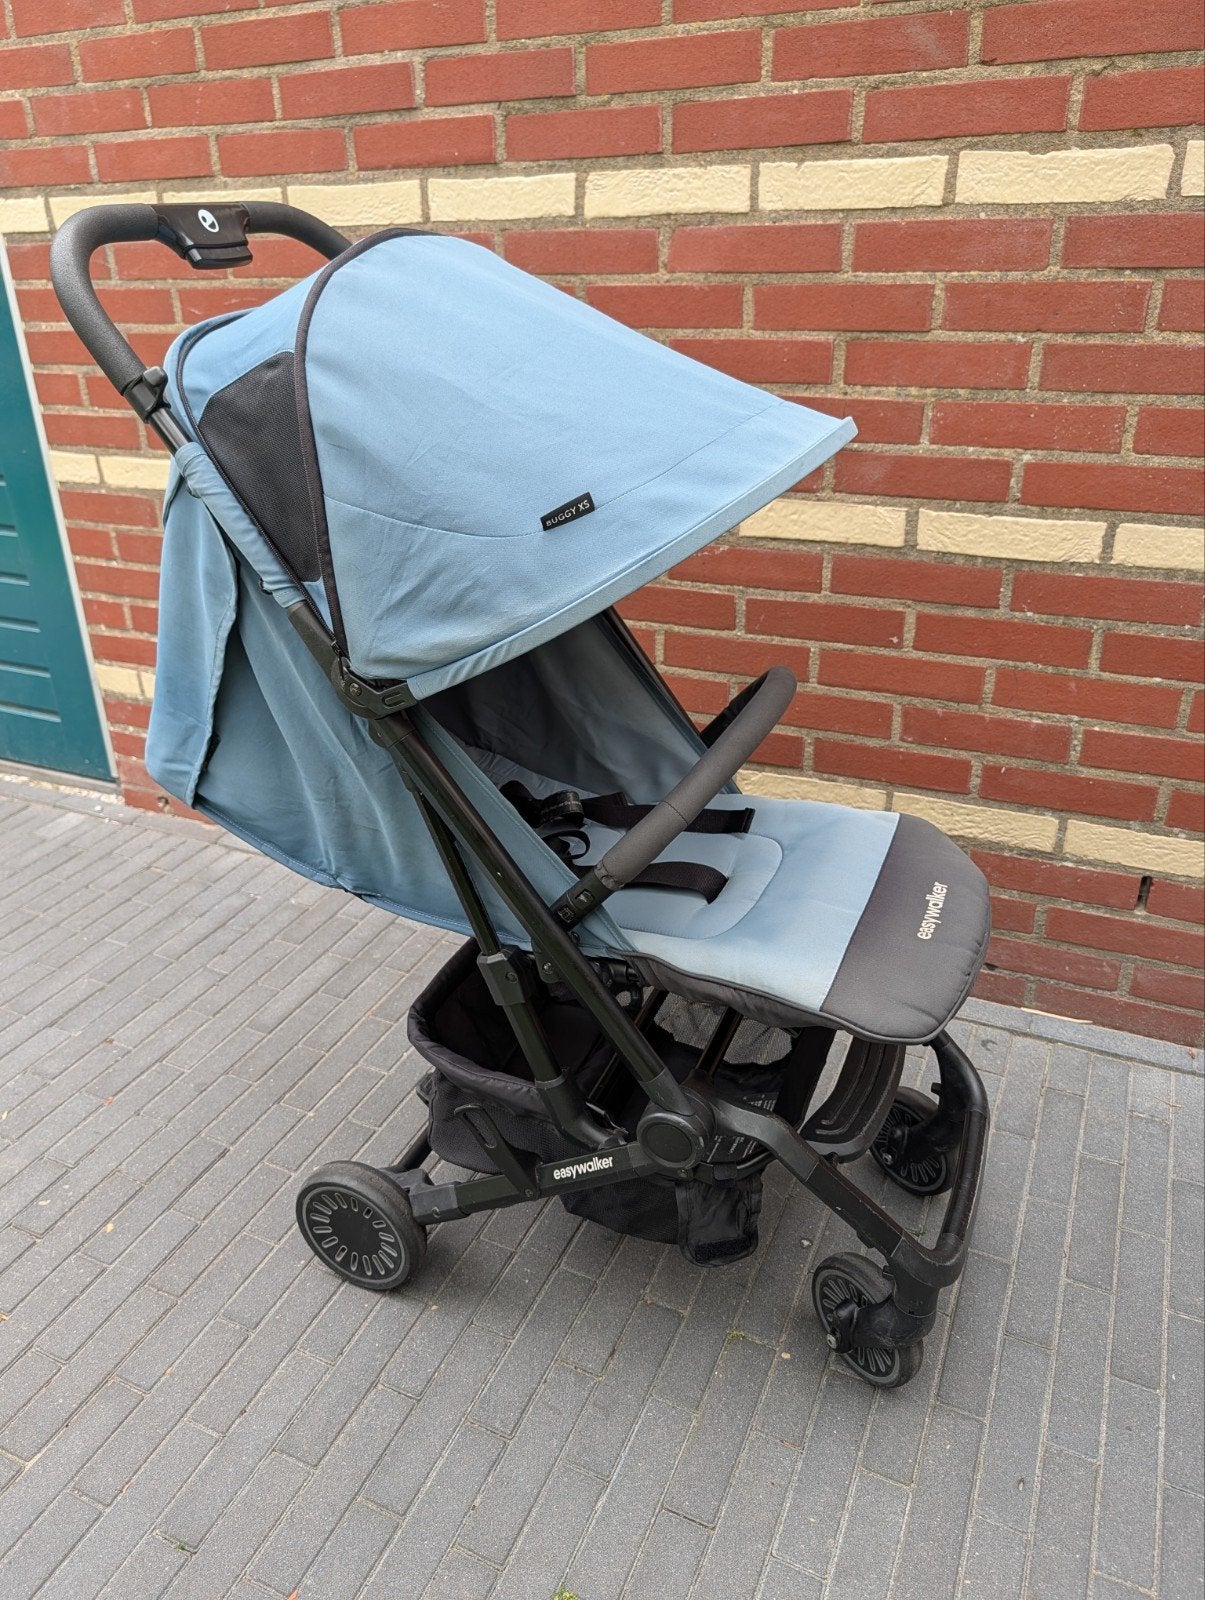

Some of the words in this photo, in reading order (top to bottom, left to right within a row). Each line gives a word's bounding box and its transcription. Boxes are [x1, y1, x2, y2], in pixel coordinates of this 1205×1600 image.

[545, 506, 576, 527] BUGGY
[577, 499, 590, 511] XS
[917, 881, 948, 940] easywalker
[553, 1156, 613, 1180] easywalker
